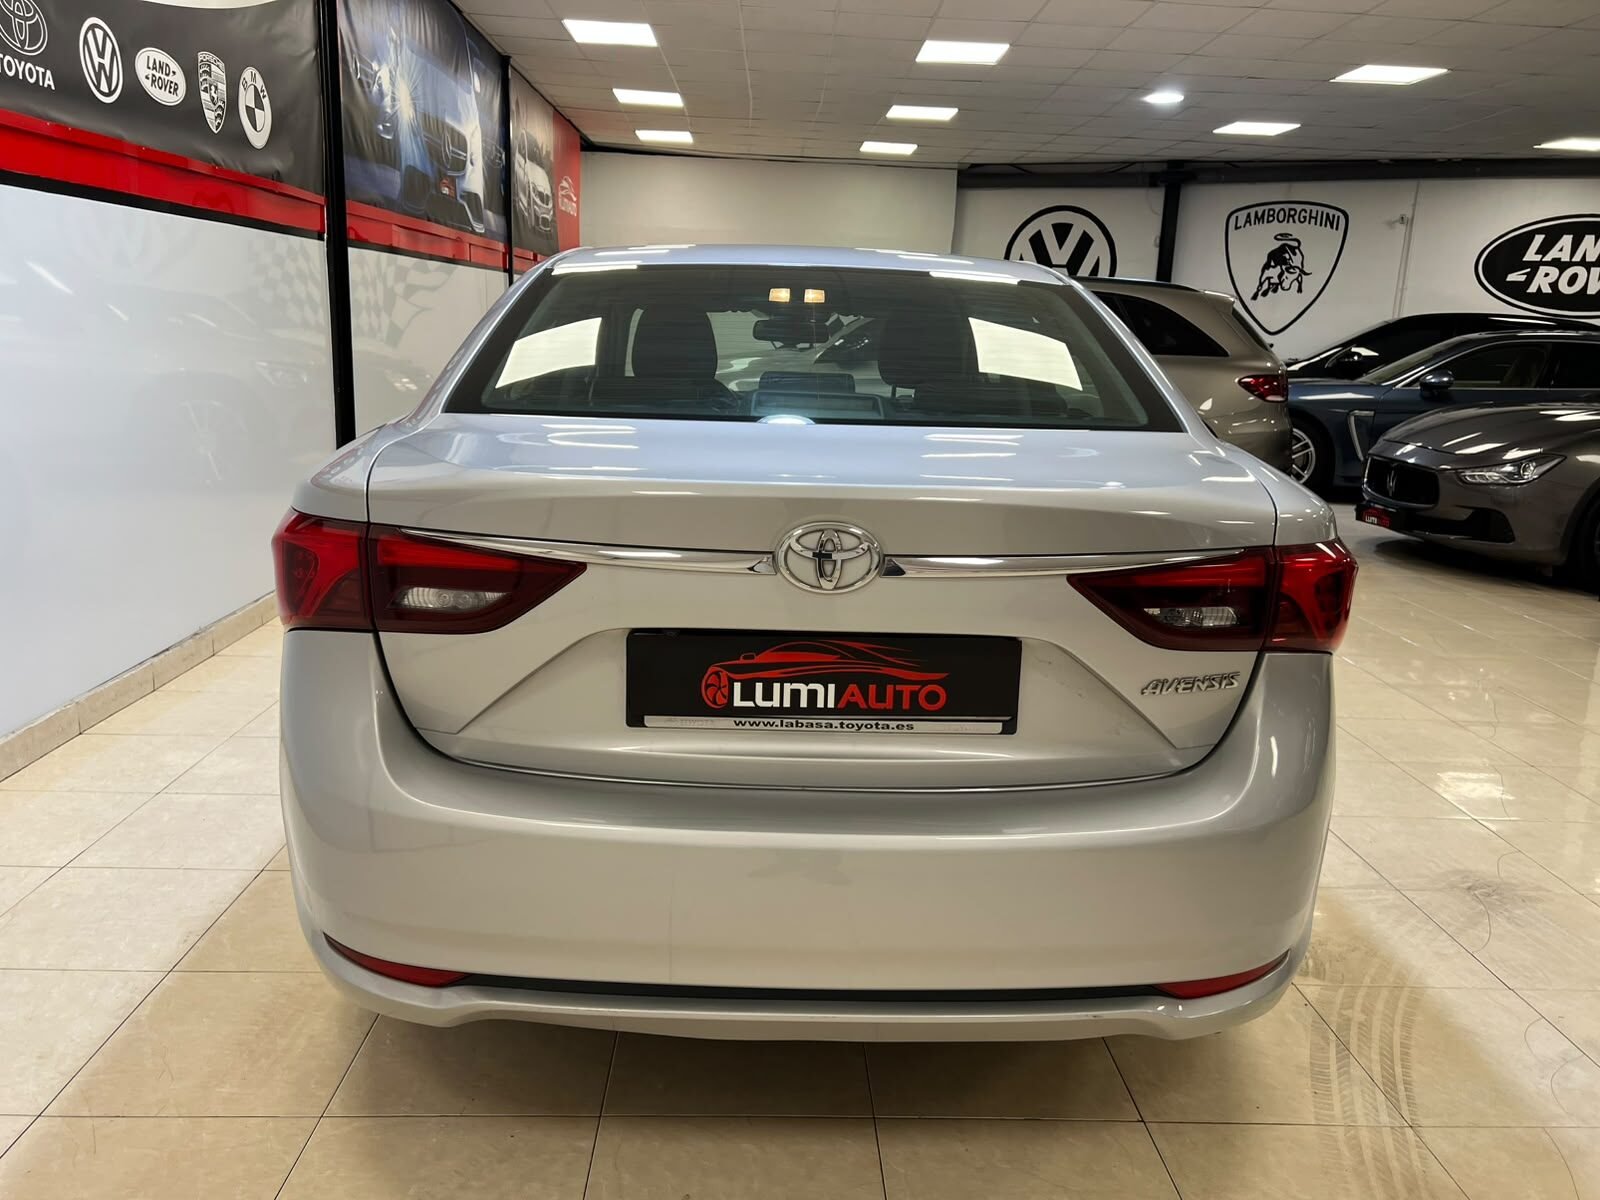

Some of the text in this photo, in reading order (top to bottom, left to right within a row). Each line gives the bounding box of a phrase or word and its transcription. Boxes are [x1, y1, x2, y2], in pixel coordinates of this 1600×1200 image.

[146, 55, 171, 77] LAND
[151, 73, 179, 97] ROVER
[1233, 207, 1341, 231] LAMBORGHINI
[1140, 671, 1241, 696] AVENSIS
[733, 719, 915, 732] www.labasa.toyota.es
